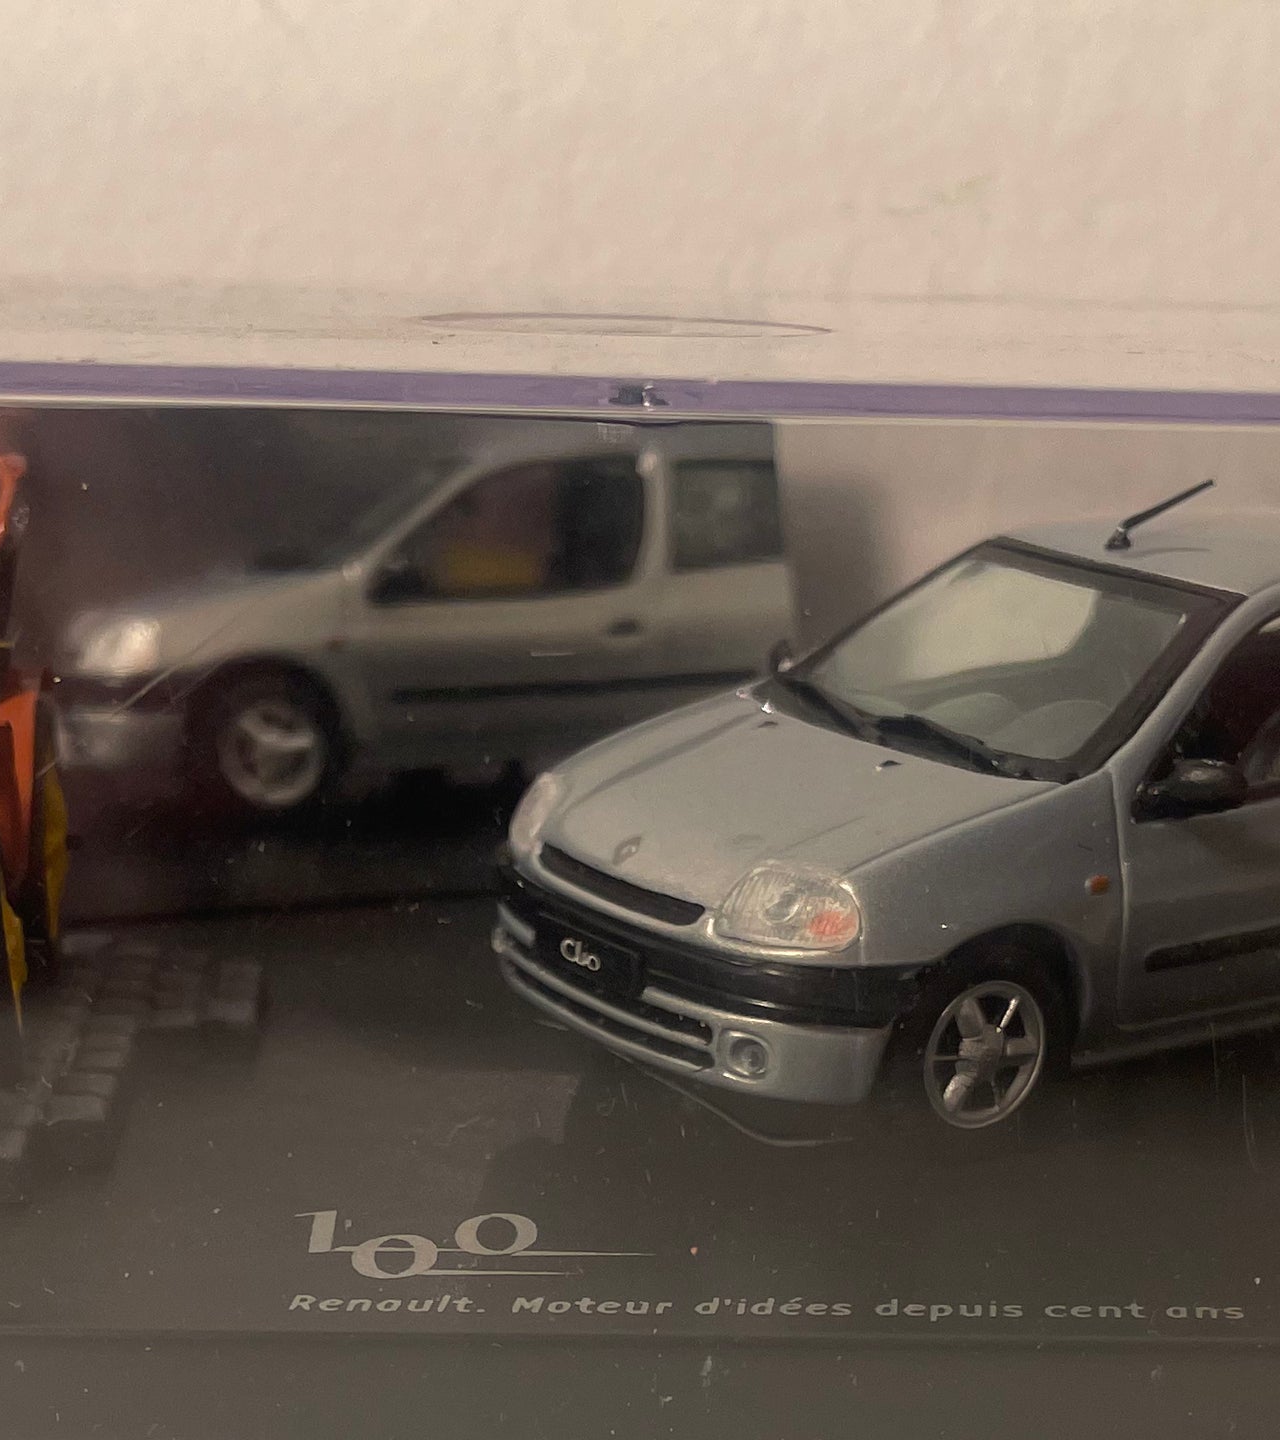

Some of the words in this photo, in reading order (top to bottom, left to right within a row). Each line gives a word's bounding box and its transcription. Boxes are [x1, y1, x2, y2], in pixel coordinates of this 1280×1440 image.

[287, 1293, 489, 1316] Renault.
[511, 1295, 674, 1318] Moteur
[694, 1297, 853, 1319] d'idées
[873, 1300, 1024, 1323] depuis
[1043, 1301, 1151, 1321] cent
[1165, 1303, 1247, 1321] ans
